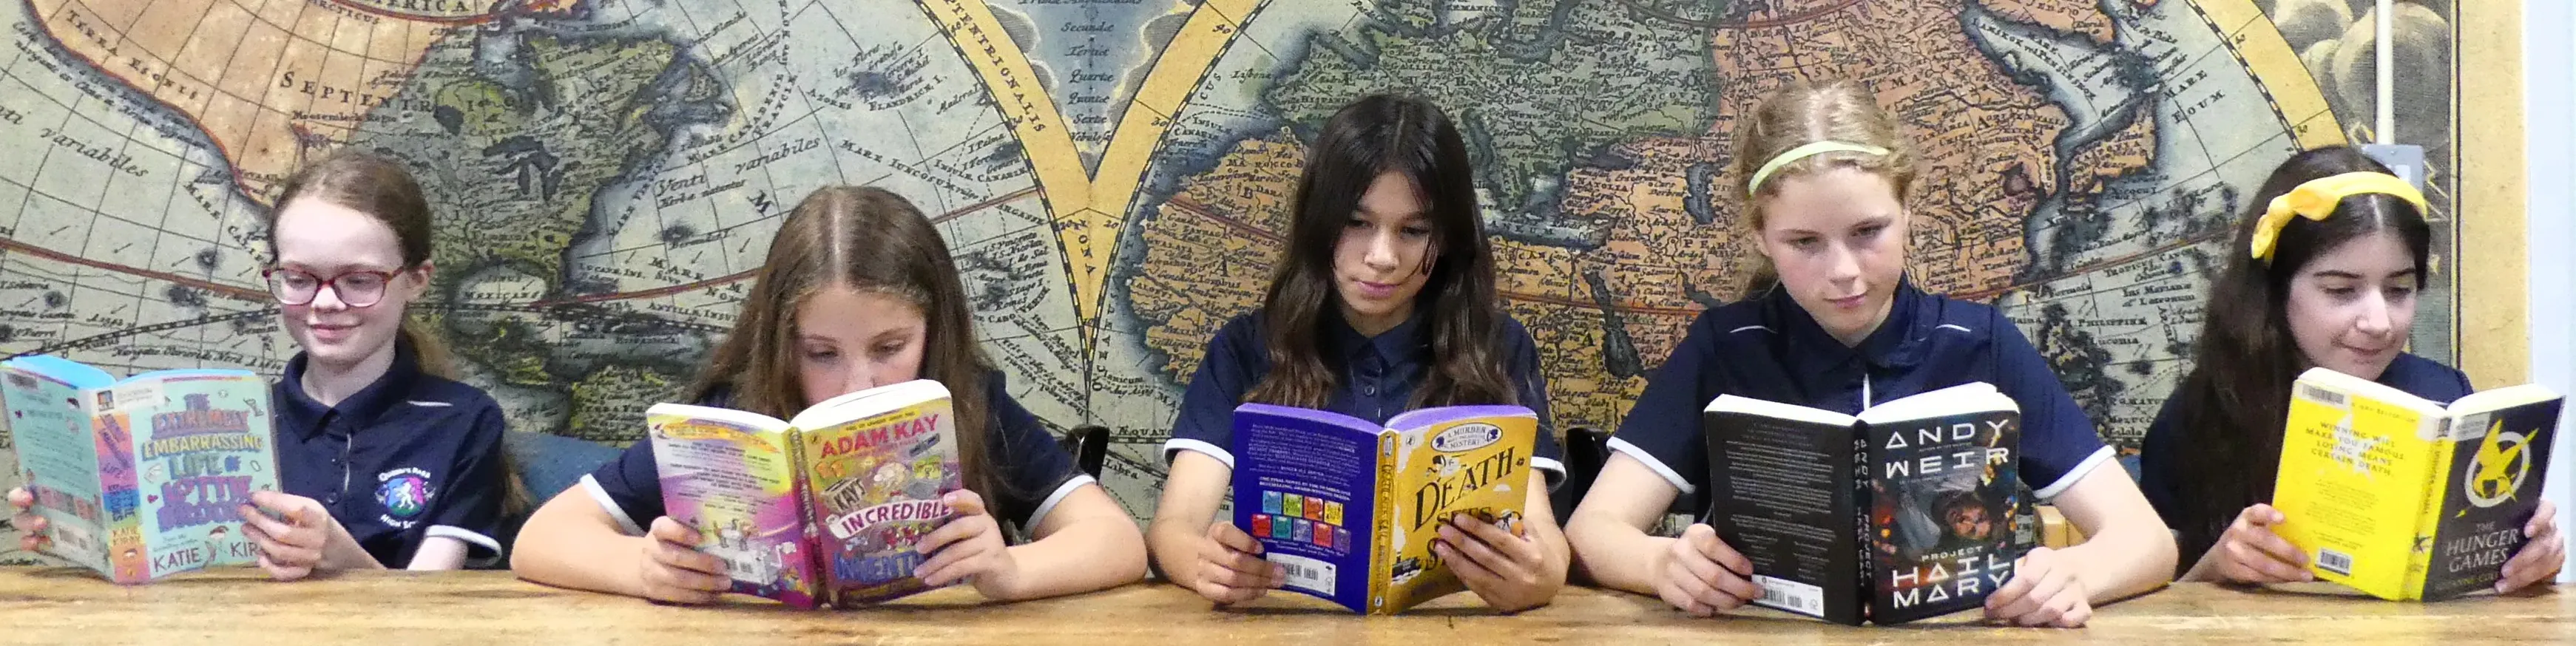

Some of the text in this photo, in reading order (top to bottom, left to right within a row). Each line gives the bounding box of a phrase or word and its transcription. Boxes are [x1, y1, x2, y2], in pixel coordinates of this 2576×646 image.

[943, 0, 1047, 132] PTENTRIONALIS
[2163, 69, 2208, 102] MARE
[40, 126, 149, 177] variabiles
[734, 135, 822, 176] variabiles
[838, 139, 884, 163] MARE
[821, 426, 890, 459] ADAM
[893, 412, 940, 441] KAY
[1886, 419, 2009, 449] ANDY
[2305, 427, 2333, 441] MAKE
[2339, 436, 2359, 447] YOU
[2319, 421, 2367, 439] WINNING
[141, 433, 264, 461] EMBARRASSING
[2310, 448, 2354, 465] CERTAIN
[169, 452, 223, 480] LIFE
[1886, 446, 2009, 480] WEIR
[1413, 446, 1516, 532] DEATH
[842, 501, 950, 535] INCREDIBLE
[2476, 520, 2496, 532] THE
[153, 541, 259, 573] KATIE KIR
[1921, 545, 1984, 562] PROJECT
[2445, 528, 2519, 557] HUNGER
[1893, 553, 2011, 588] HAIL
[2448, 547, 2509, 574] GAMES
[1893, 570, 2009, 610] MARY
